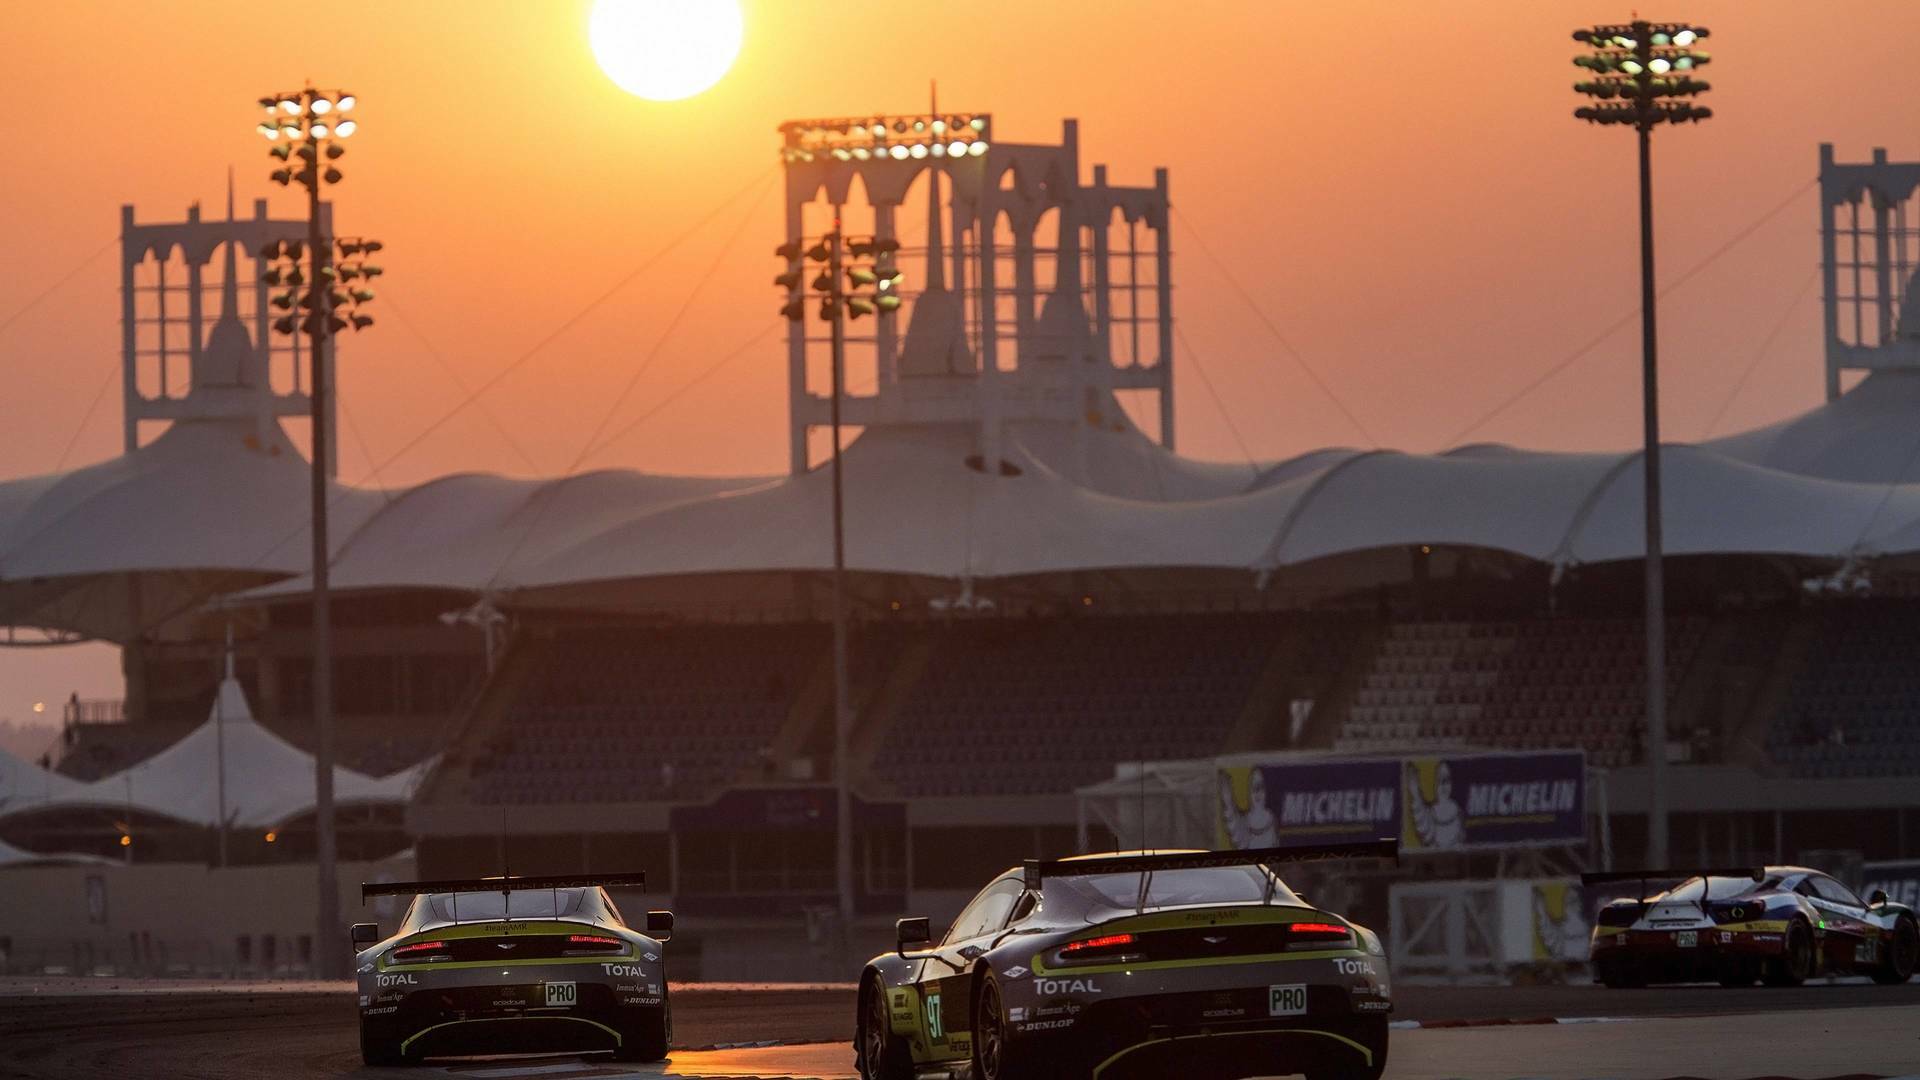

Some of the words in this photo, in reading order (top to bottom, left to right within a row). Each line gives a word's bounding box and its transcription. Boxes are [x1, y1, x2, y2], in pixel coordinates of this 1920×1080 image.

[1281, 788, 1395, 823] MICHELIN
[1467, 779, 1577, 815] MICHELIN
[1679, 933, 1697, 945] PRO
[600, 963, 647, 977] TOTAL
[1332, 957, 1376, 975] TOTAL
[376, 974, 418, 987] TOTAL
[1033, 977, 1102, 995] TOTAL
[547, 984, 575, 1001] PRO
[629, 996, 661, 1005] DUNLOP
[1271, 988, 1304, 1011] PRO
[368, 1005, 398, 1016] DUNLOP
[926, 994, 943, 1038] 97
[1025, 1018, 1075, 1031] DUNLOP
